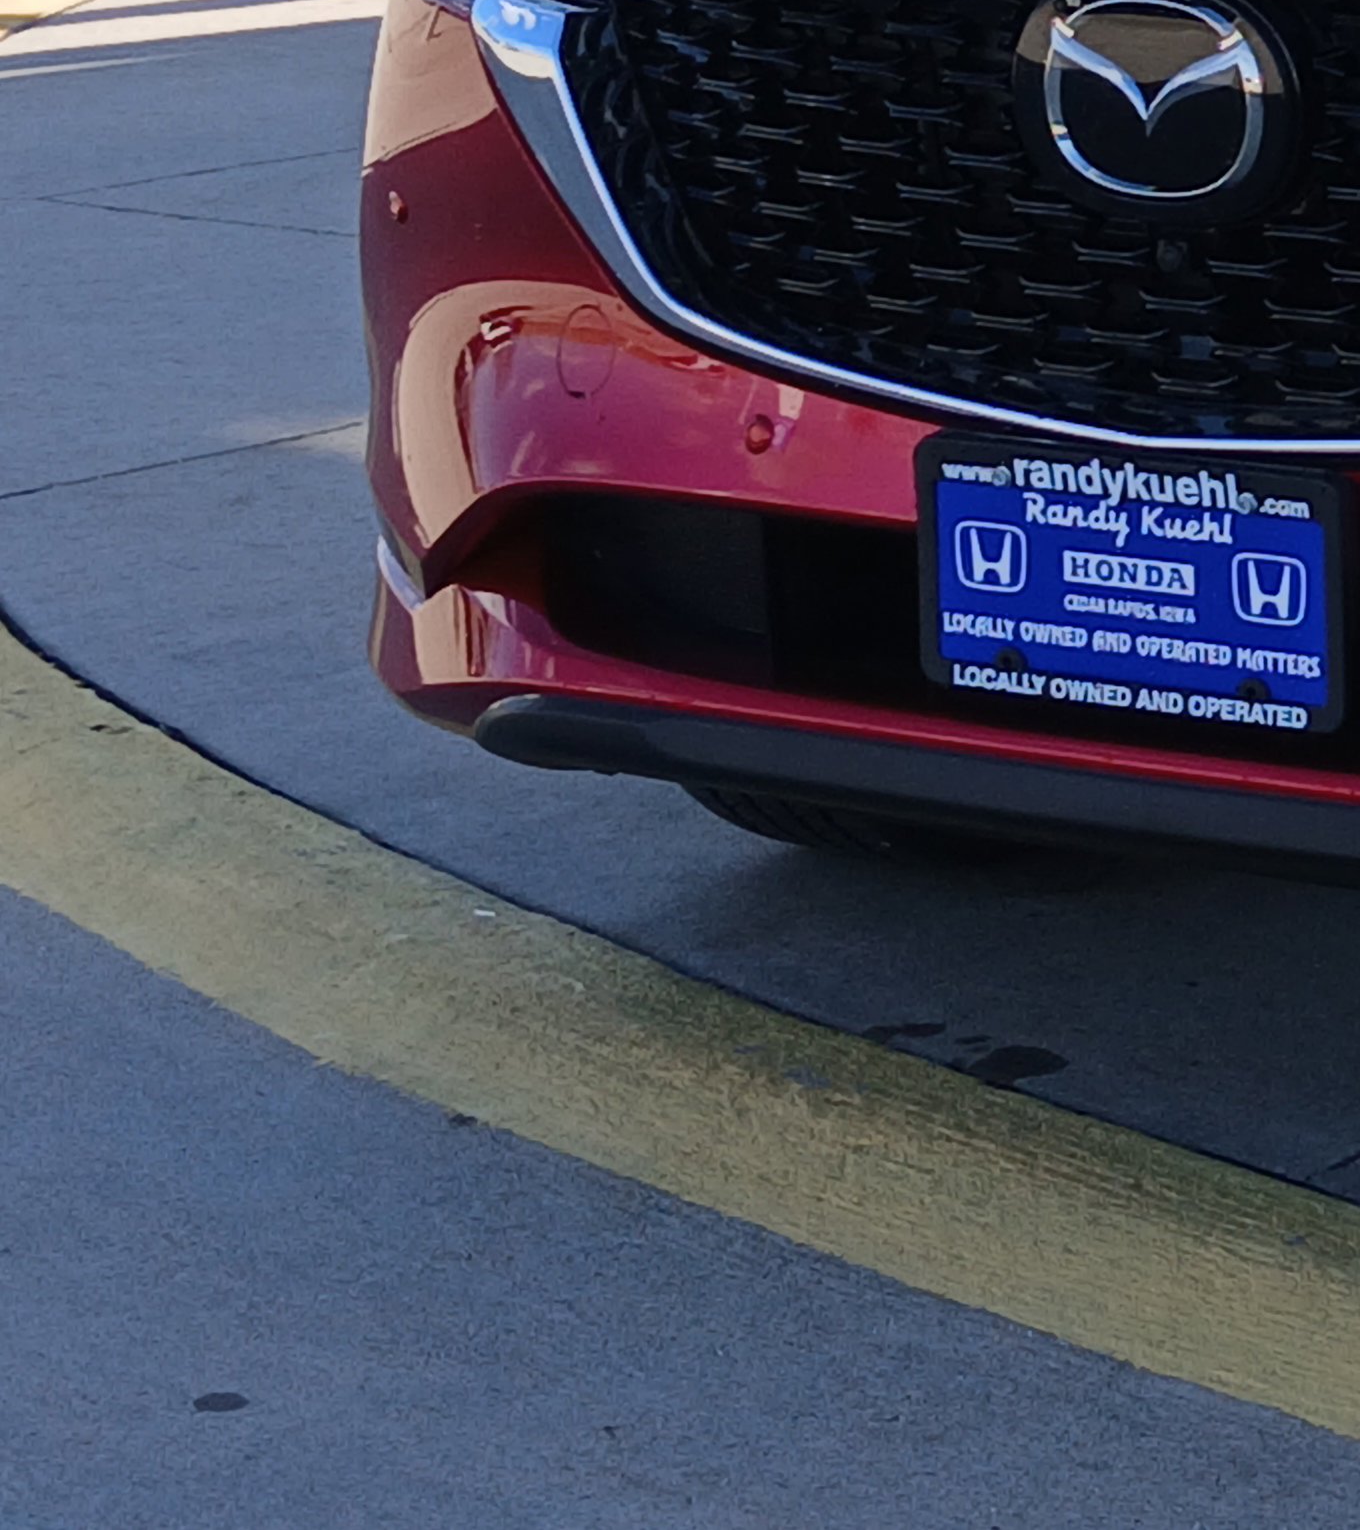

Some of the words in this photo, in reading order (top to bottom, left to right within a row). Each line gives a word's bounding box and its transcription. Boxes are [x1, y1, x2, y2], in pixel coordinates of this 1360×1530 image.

[1023, 492, 1130, 547] Randy
[1141, 506, 1233, 544] Kuehl
[1071, 556, 1189, 590] HONDA
[943, 612, 1016, 641] LOCALLY
[1020, 621, 1088, 647] OWNED
[1092, 630, 1131, 653] AND
[1136, 635, 1232, 666] OPERATED
[953, 663, 1046, 695] LOCALLY
[1050, 677, 1132, 707] OWNED
[1135, 688, 1184, 714] AND
[1188, 695, 1308, 729] OPERATED
